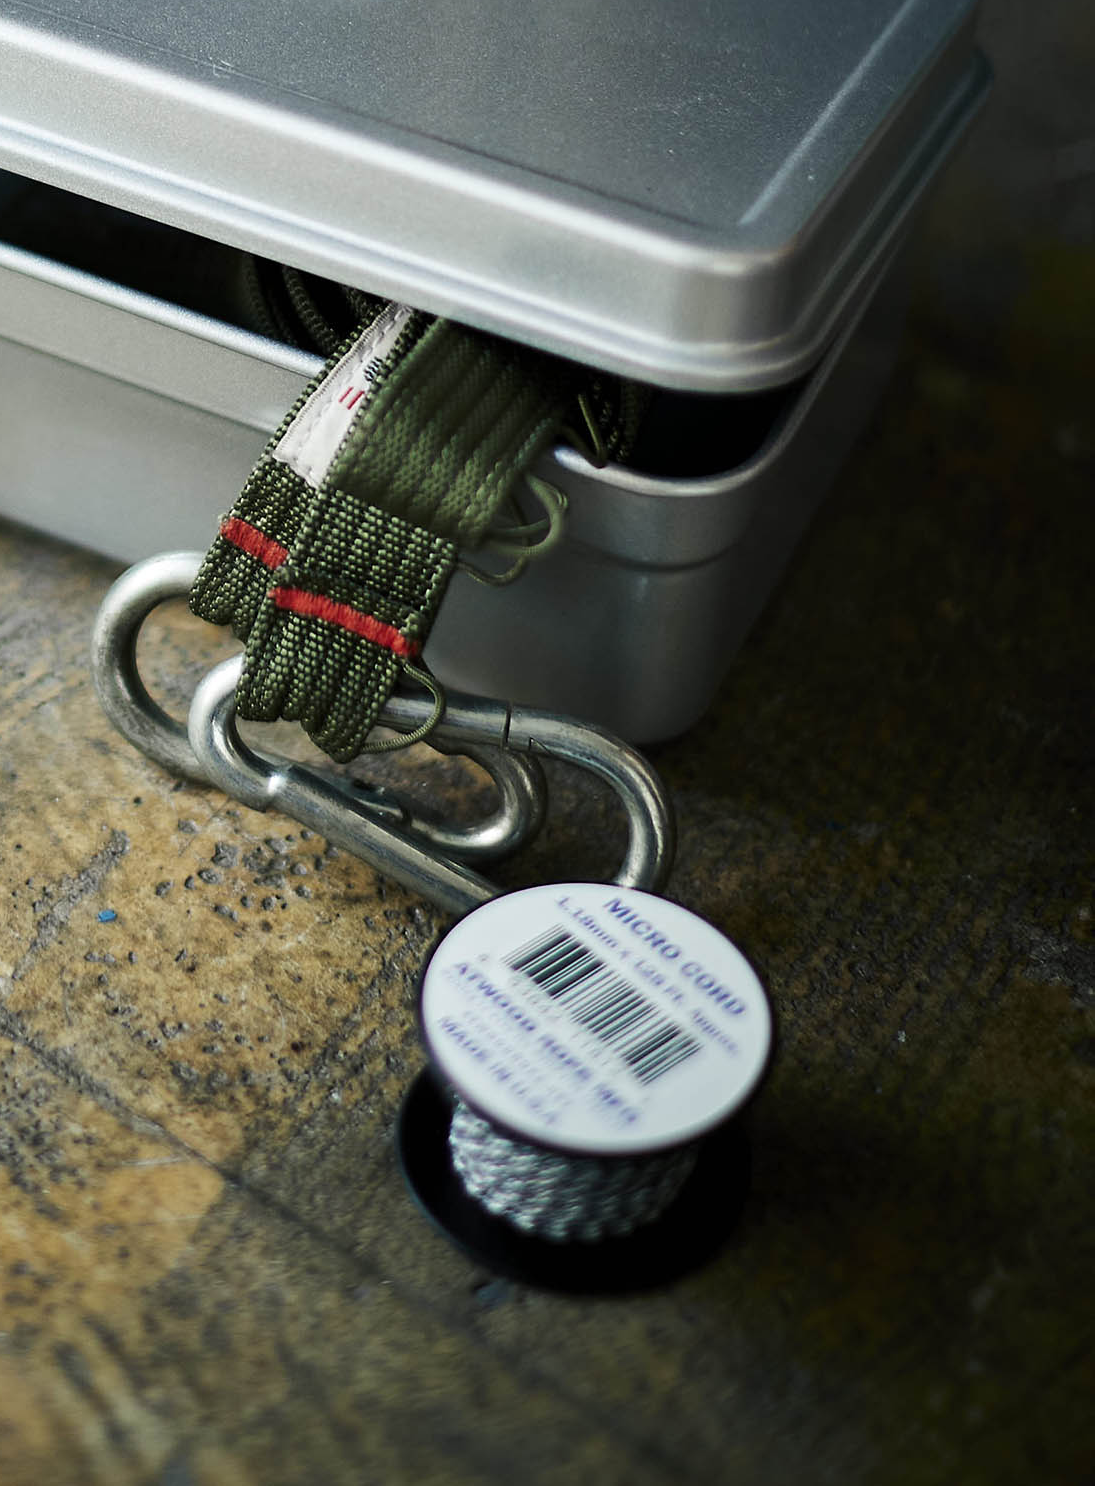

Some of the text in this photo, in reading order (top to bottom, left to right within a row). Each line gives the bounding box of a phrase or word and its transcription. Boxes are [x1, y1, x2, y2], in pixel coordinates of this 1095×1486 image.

[456, 963, 537, 1033] ATWOOD
[603, 898, 746, 1015] MICRO CORD
